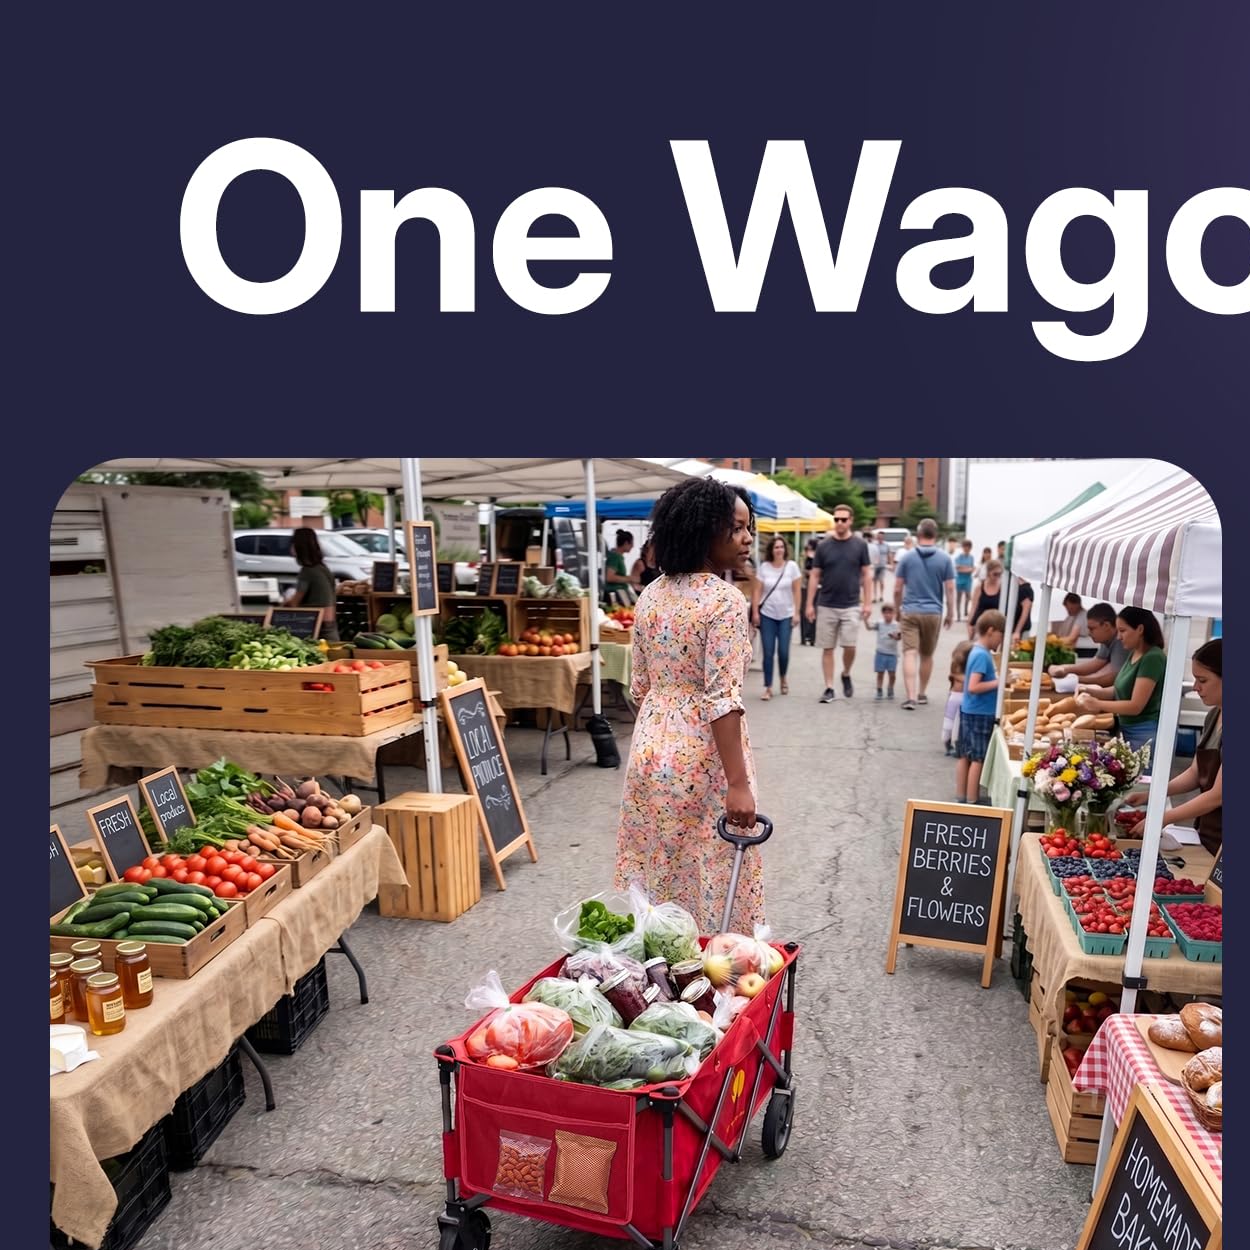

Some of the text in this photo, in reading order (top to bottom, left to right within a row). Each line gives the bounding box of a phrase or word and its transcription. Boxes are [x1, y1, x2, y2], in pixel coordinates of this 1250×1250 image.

[151, 780, 178, 807] Local
[98, 810, 132, 838] FRESH
[160, 804, 186, 828] produce
[923, 822, 988, 850] FRESH
[913, 848, 992, 877] BERRIES
[940, 876, 953, 897] &
[907, 896, 985, 928] FLOWERS
